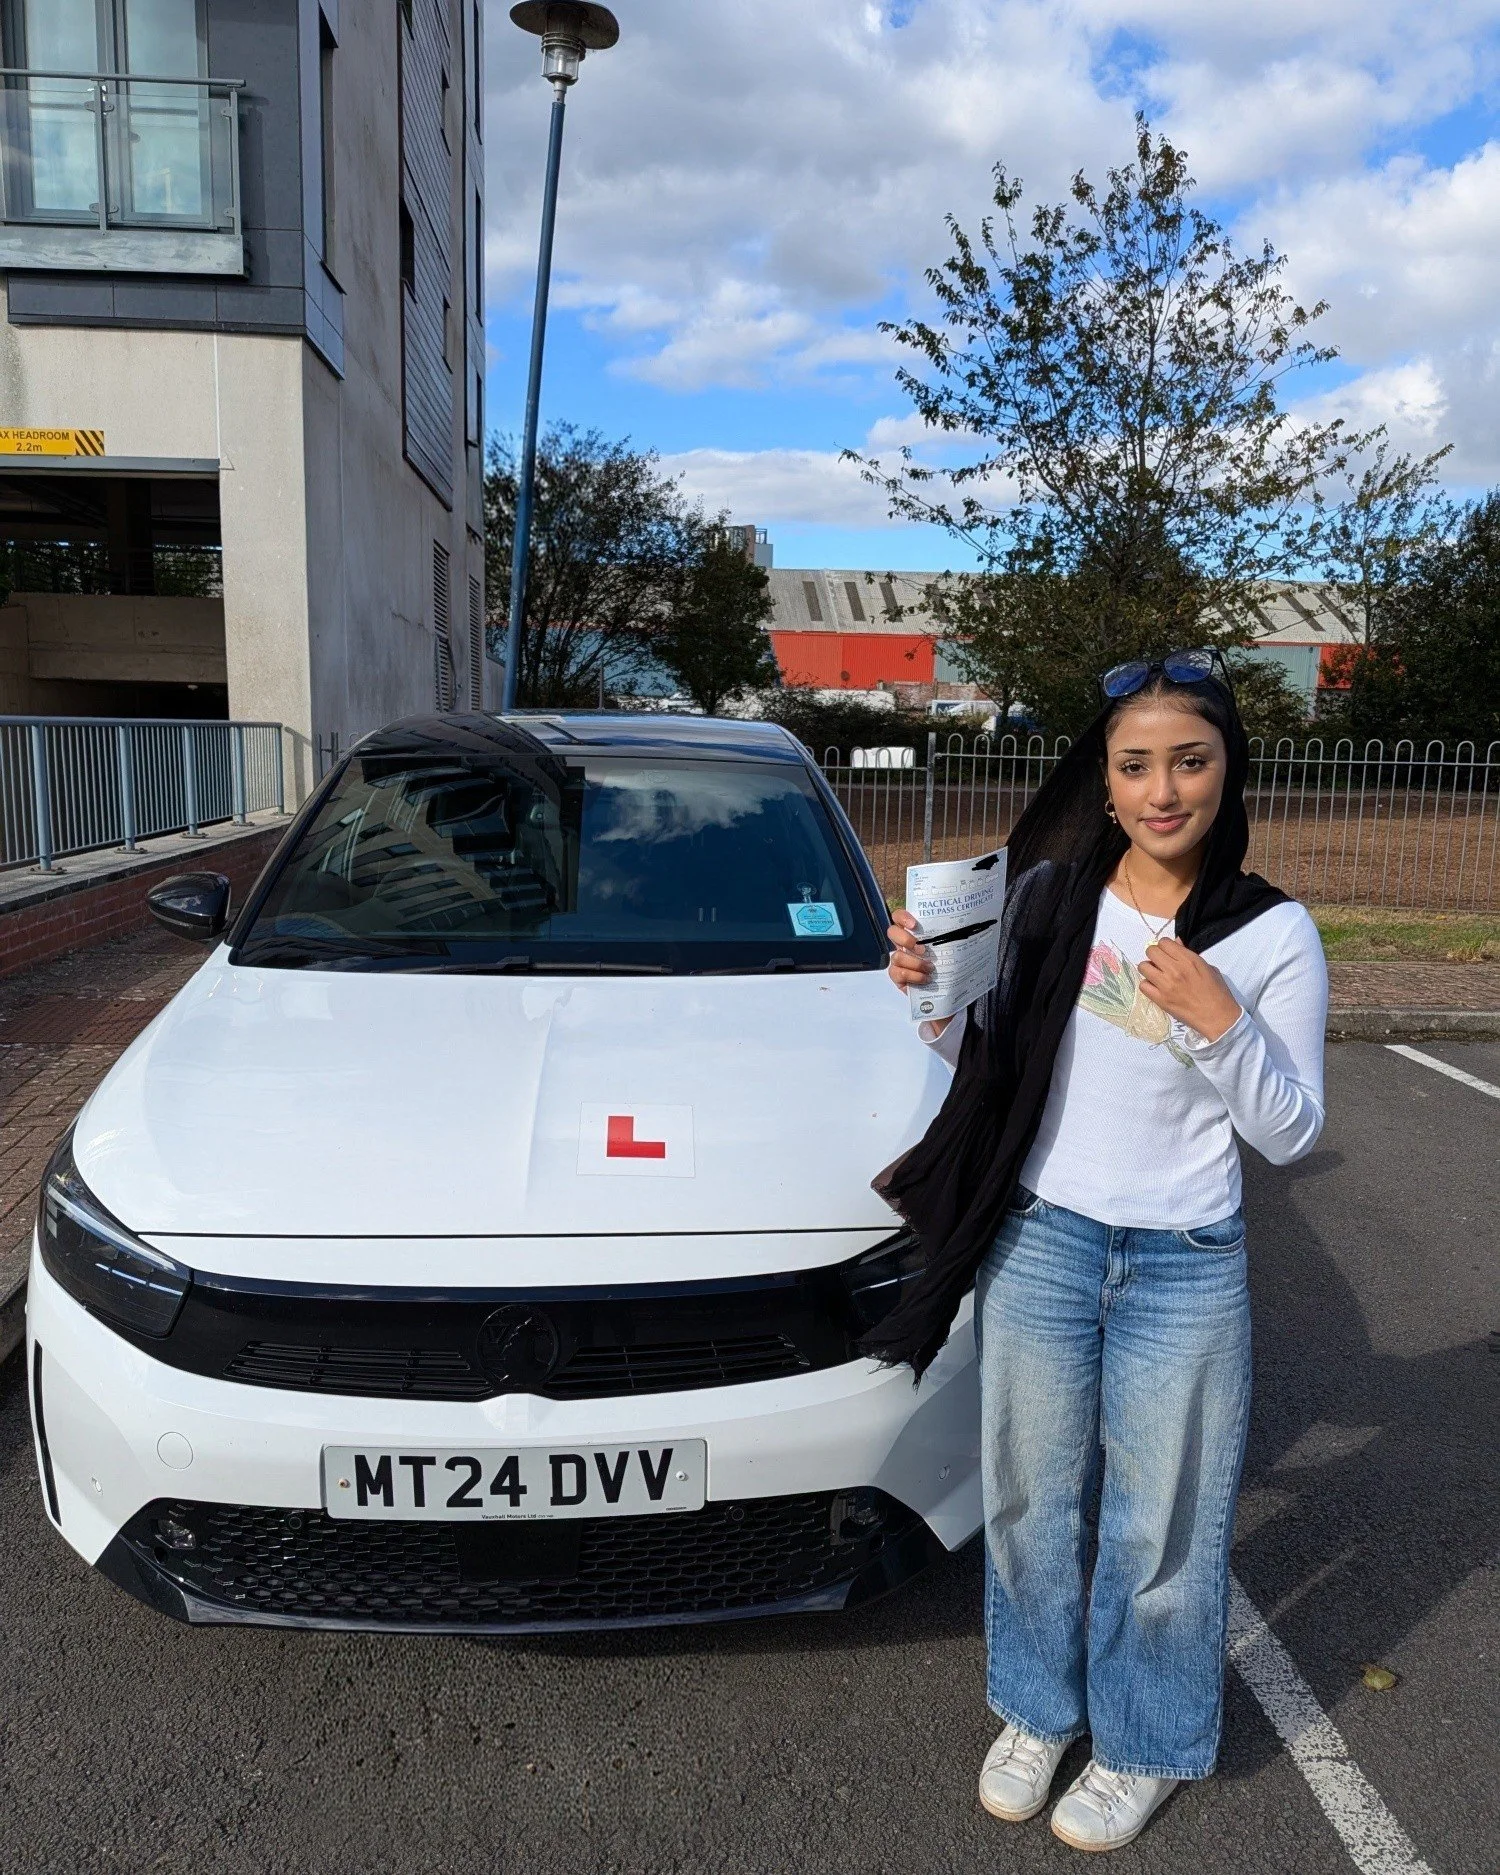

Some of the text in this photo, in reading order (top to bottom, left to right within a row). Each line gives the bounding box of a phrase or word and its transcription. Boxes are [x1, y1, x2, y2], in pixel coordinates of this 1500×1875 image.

[12, 430, 70, 441] HEADROOM
[16, 442, 43, 452] 2.2m
[918, 886, 994, 909] PRACTICAL DRIVING
[919, 894, 994, 917] TEST PASS CERTIFICATE
[606, 1115, 666, 1159] L
[354, 1448, 674, 1508] MT24 DVV
